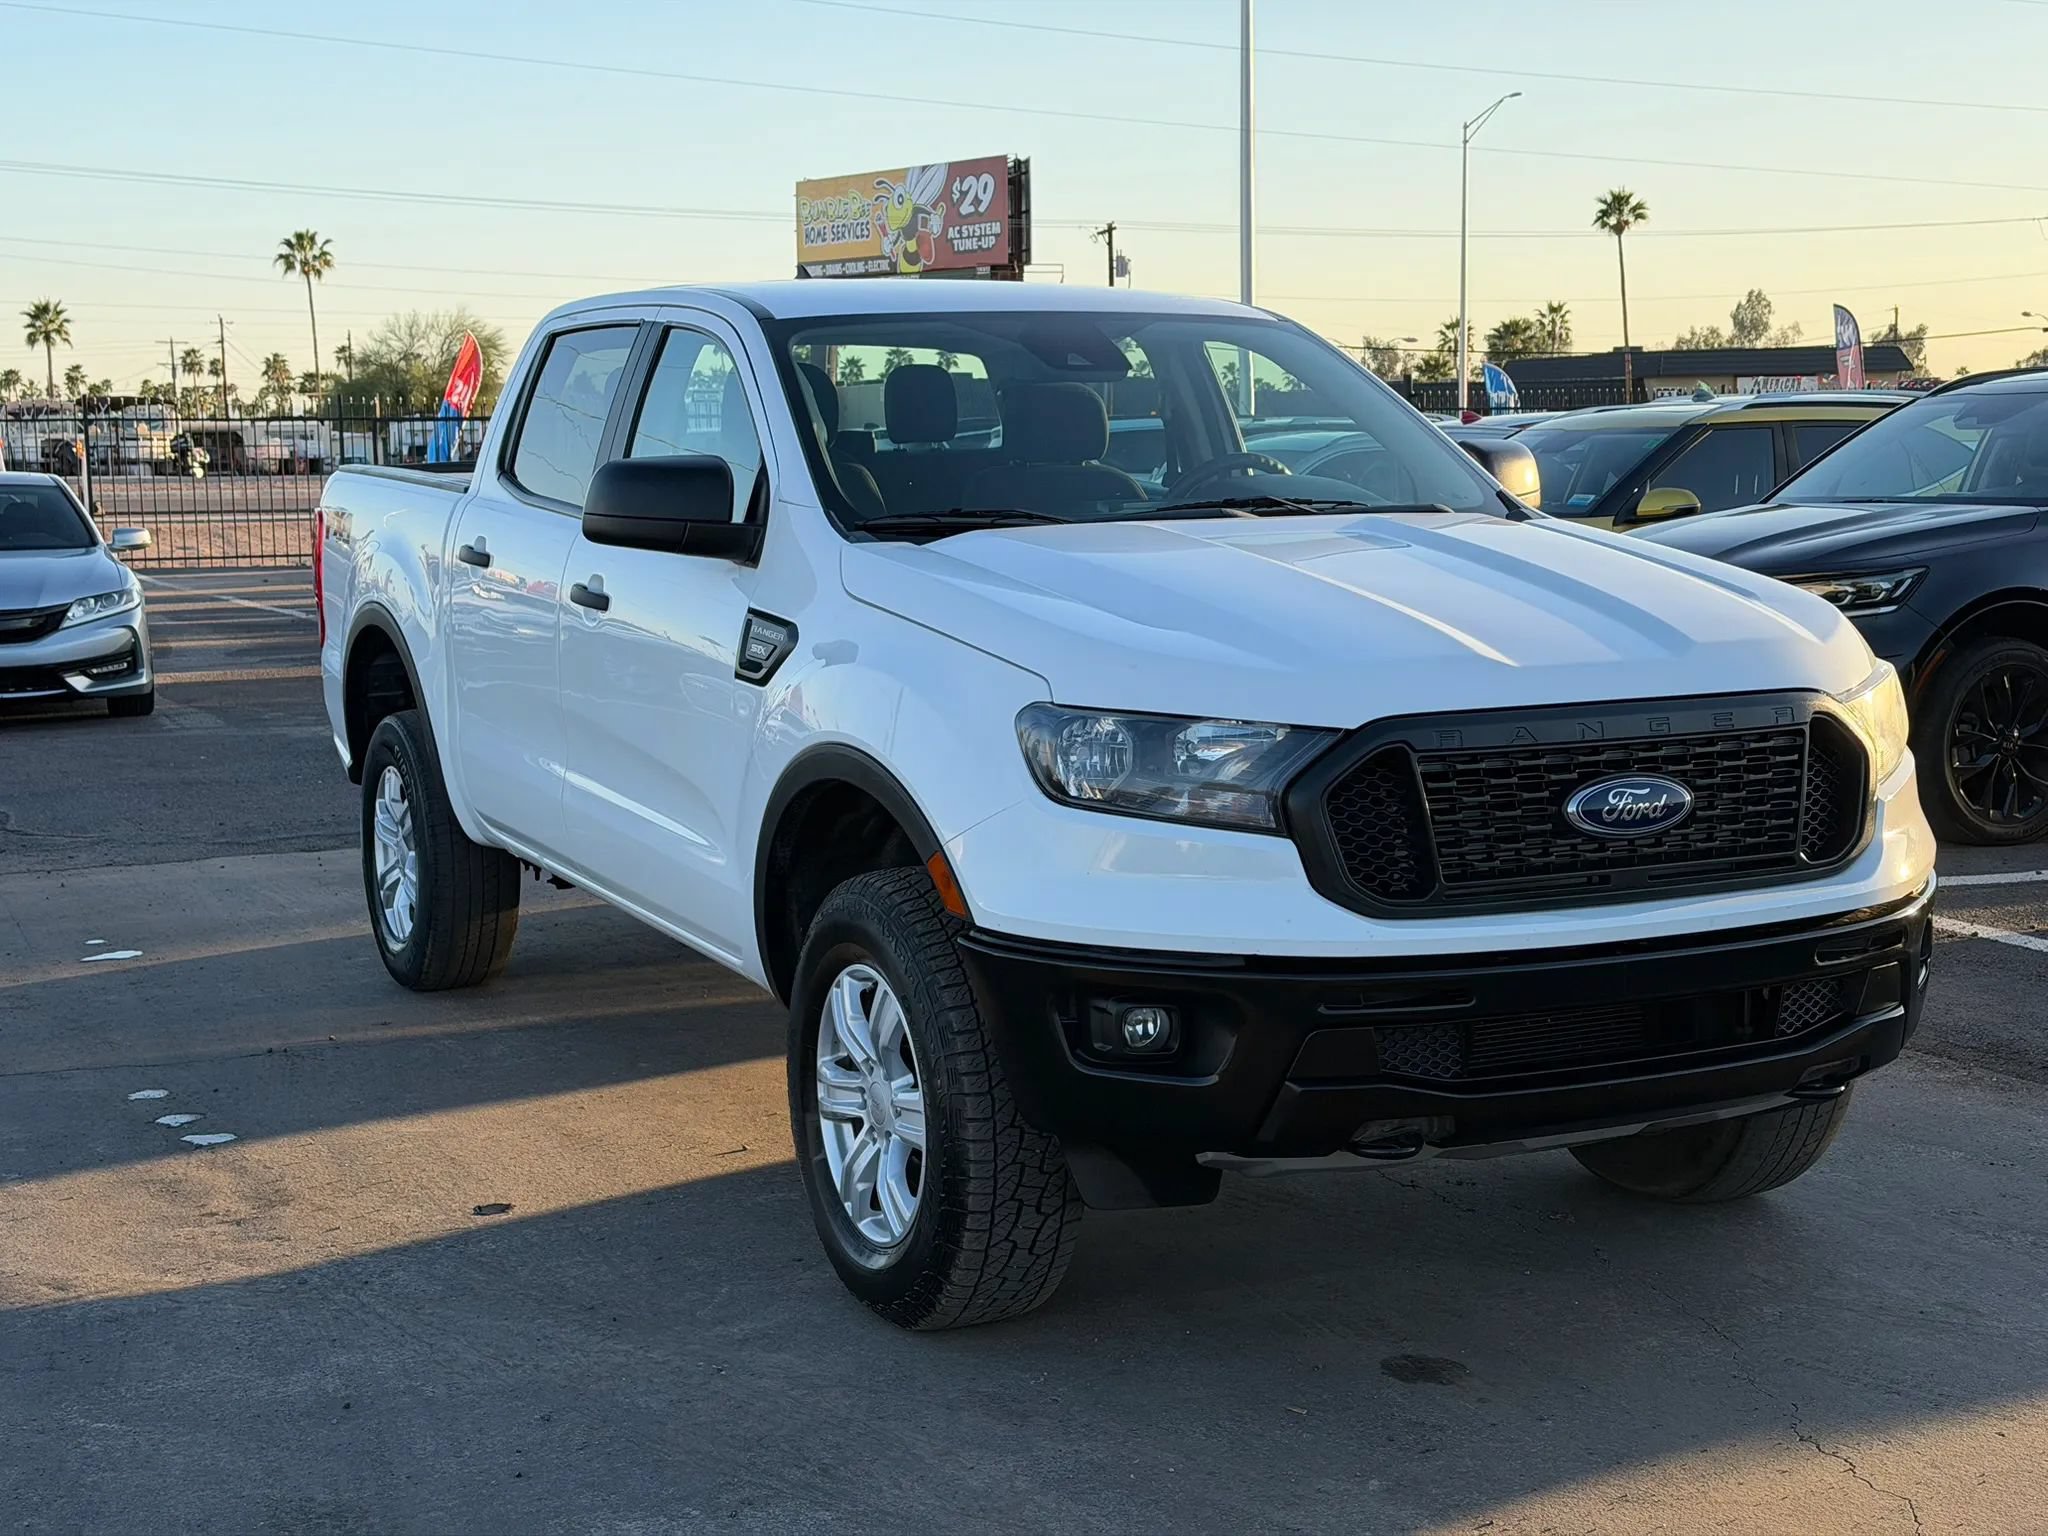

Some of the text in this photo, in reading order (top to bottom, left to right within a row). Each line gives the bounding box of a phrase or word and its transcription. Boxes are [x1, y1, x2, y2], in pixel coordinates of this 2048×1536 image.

[848, 192, 872, 221] BEE
[952, 173, 995, 216] $29
[804, 220, 871, 245] HOME SERVICES
[947, 222, 1001, 239] AC SYSTEM
[953, 236, 996, 251] TUNE-UP
[751, 625, 784, 641] RANGER
[1433, 707, 1795, 748] RANGER
[1602, 787, 1668, 823] Ford
